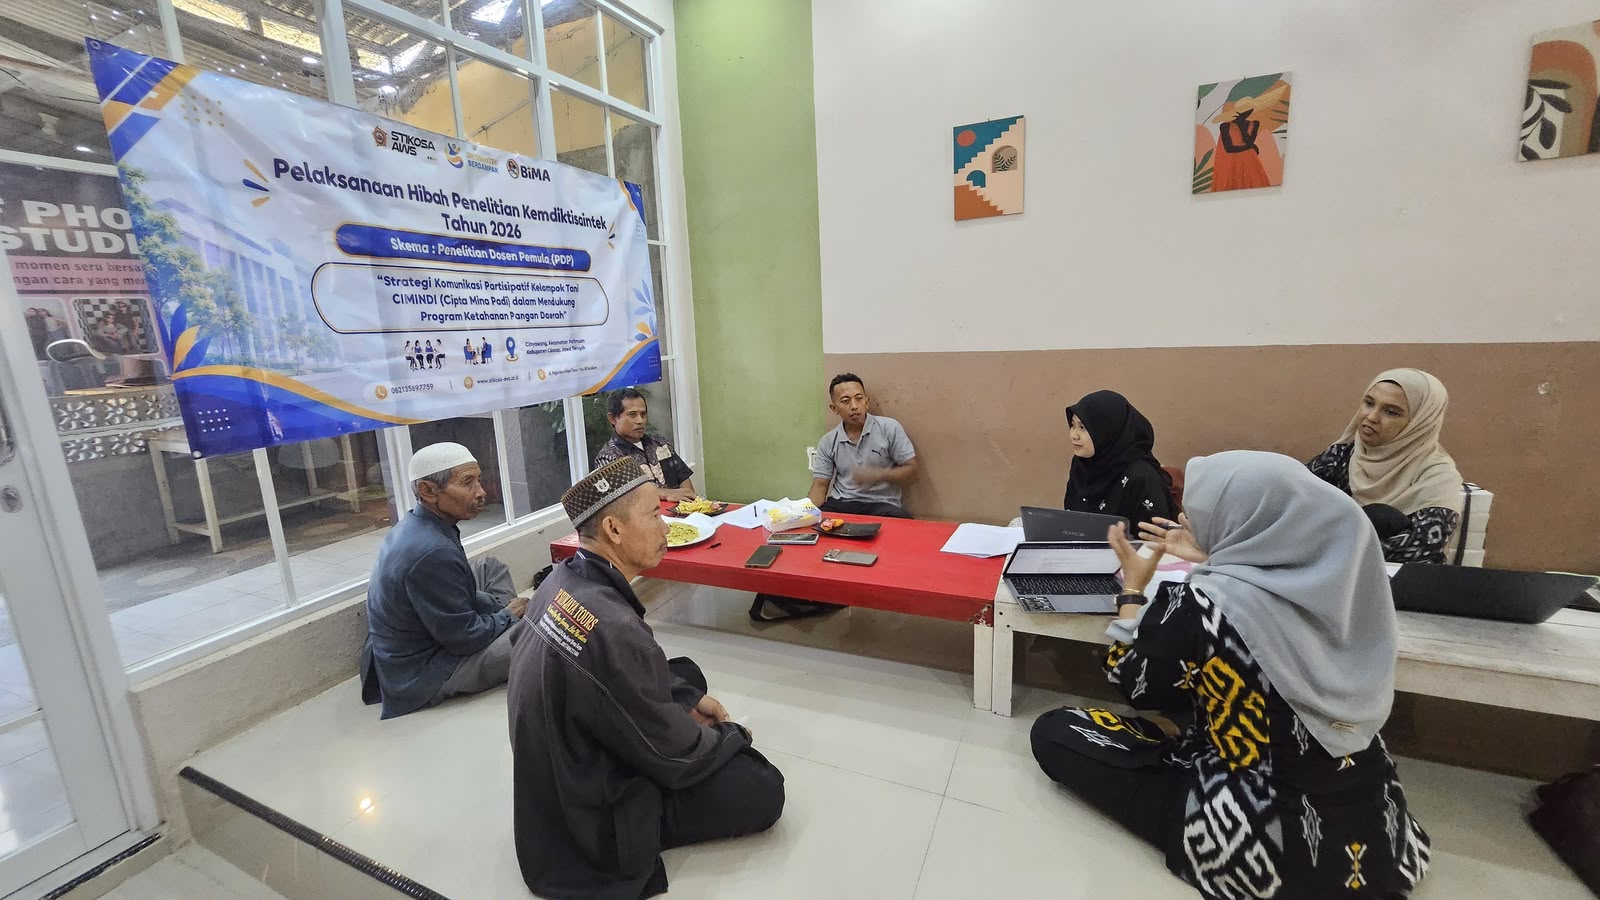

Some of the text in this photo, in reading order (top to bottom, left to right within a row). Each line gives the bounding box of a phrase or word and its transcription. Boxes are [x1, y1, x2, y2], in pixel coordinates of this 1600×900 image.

[391, 131, 436, 151] STIKOSA
[391, 142, 417, 156] AWS
[468, 160, 499, 173] BERDAMPAK
[520, 165, 551, 182] BiMA
[273, 158, 607, 230] Pelaksanaan Hibah Penelitian Kemdiktisaintek
[441, 213, 522, 239] Tahun 2026
[390, 237, 429, 254] Skema
[437, 244, 488, 259] Penelitian
[489, 248, 518, 262] Dosen
[519, 250, 549, 264] Pemula
[551, 252, 574, 267] (PDP)
[15, 261, 145, 272] momen seru bersa
[54, 276, 83, 285] cara
[85, 276, 119, 287] yang
[377, 274, 579, 296] “Strategi Komunikasi Partisipatif Kelompok Tani
[392, 293, 575, 308] CIMINDI (Cipta Mina Padi) dalam Mendukung
[420, 311, 463, 324] Program
[464, 311, 509, 321] Ketahanan
[510, 311, 539, 322] Pangan
[391, 383, 434, 394] 082135697759
[573, 605, 599, 631] TOURS
